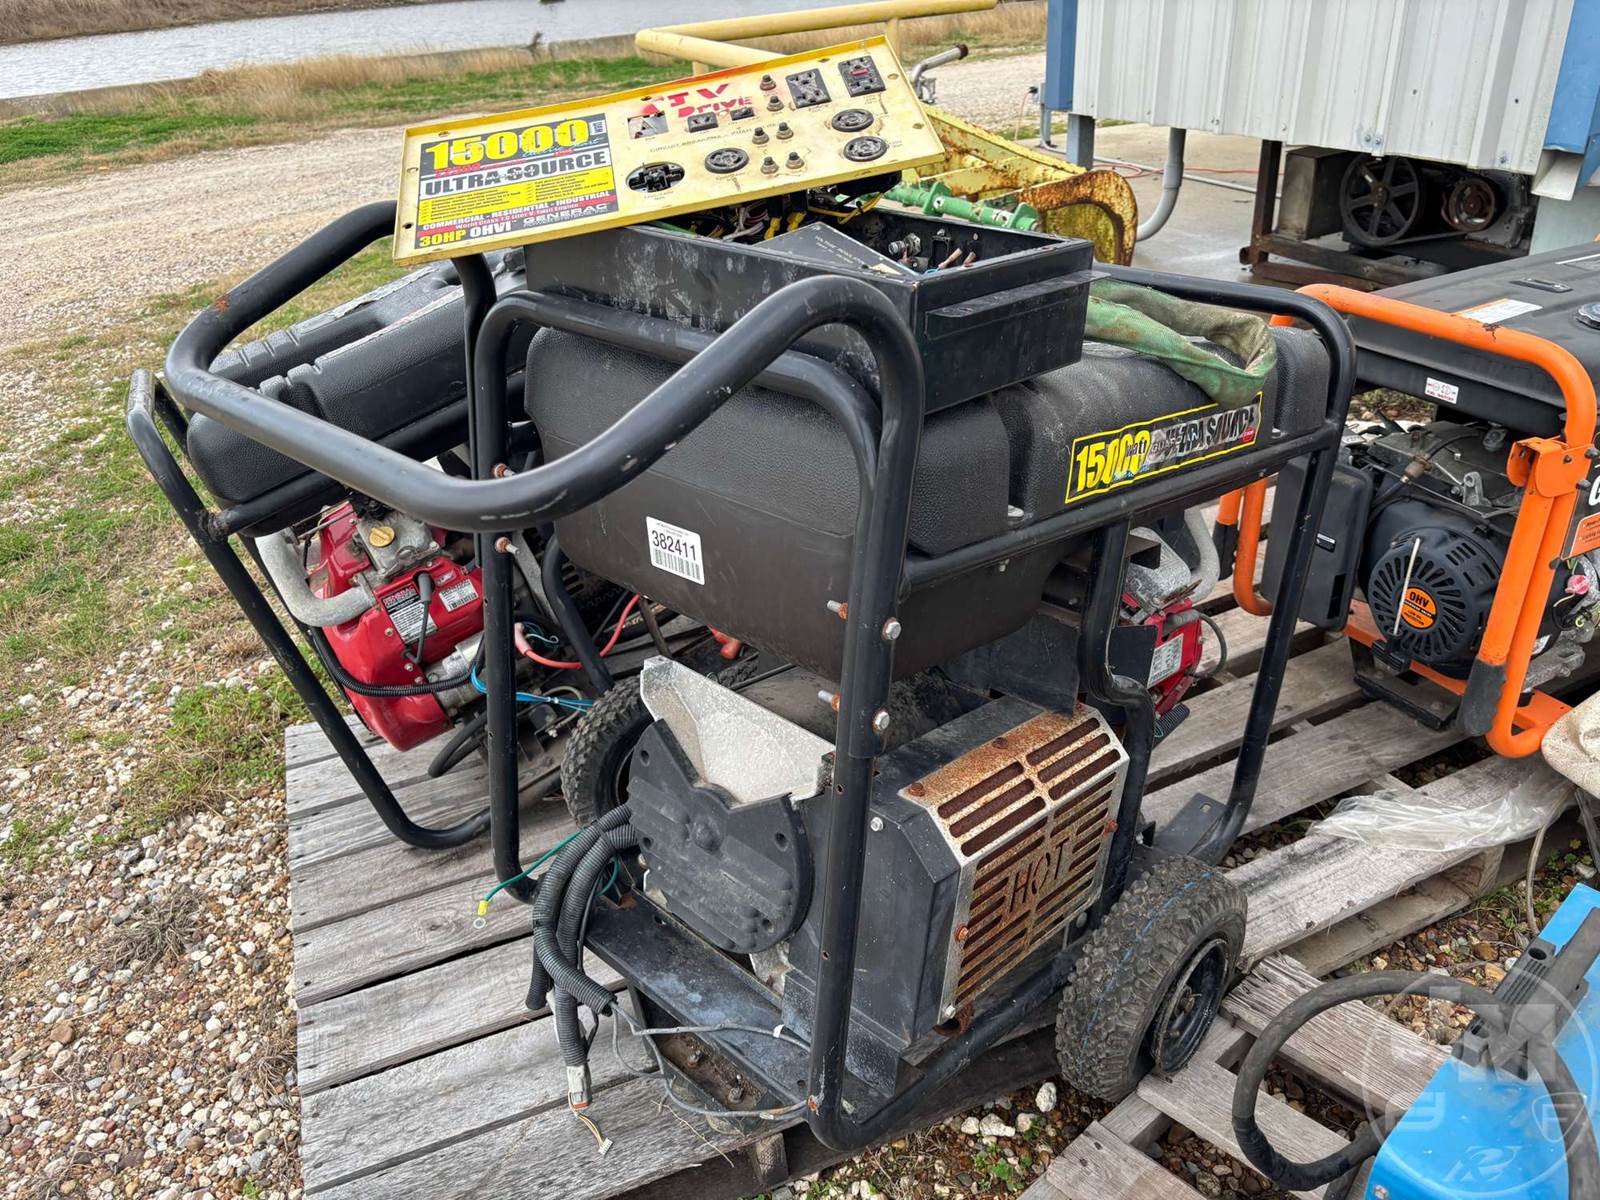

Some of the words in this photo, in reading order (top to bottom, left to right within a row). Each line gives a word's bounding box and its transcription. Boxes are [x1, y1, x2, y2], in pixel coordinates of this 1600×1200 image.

[426, 119, 589, 170] 15000
[425, 171, 500, 196] ULTRA
[505, 151, 607, 182] SOURCE
[422, 213, 485, 231] COMMERCIAL
[491, 202, 549, 218] RESIDENTIAL
[556, 190, 610, 207] INDUSTRIAL
[523, 203, 608, 224] GENERAC
[419, 229, 467, 247] 30HP
[1076, 430, 1151, 492] 15000
[651, 529, 696, 561] 382411
[1409, 591, 1430, 607] OHV
[1009, 837, 1070, 913] HOT
